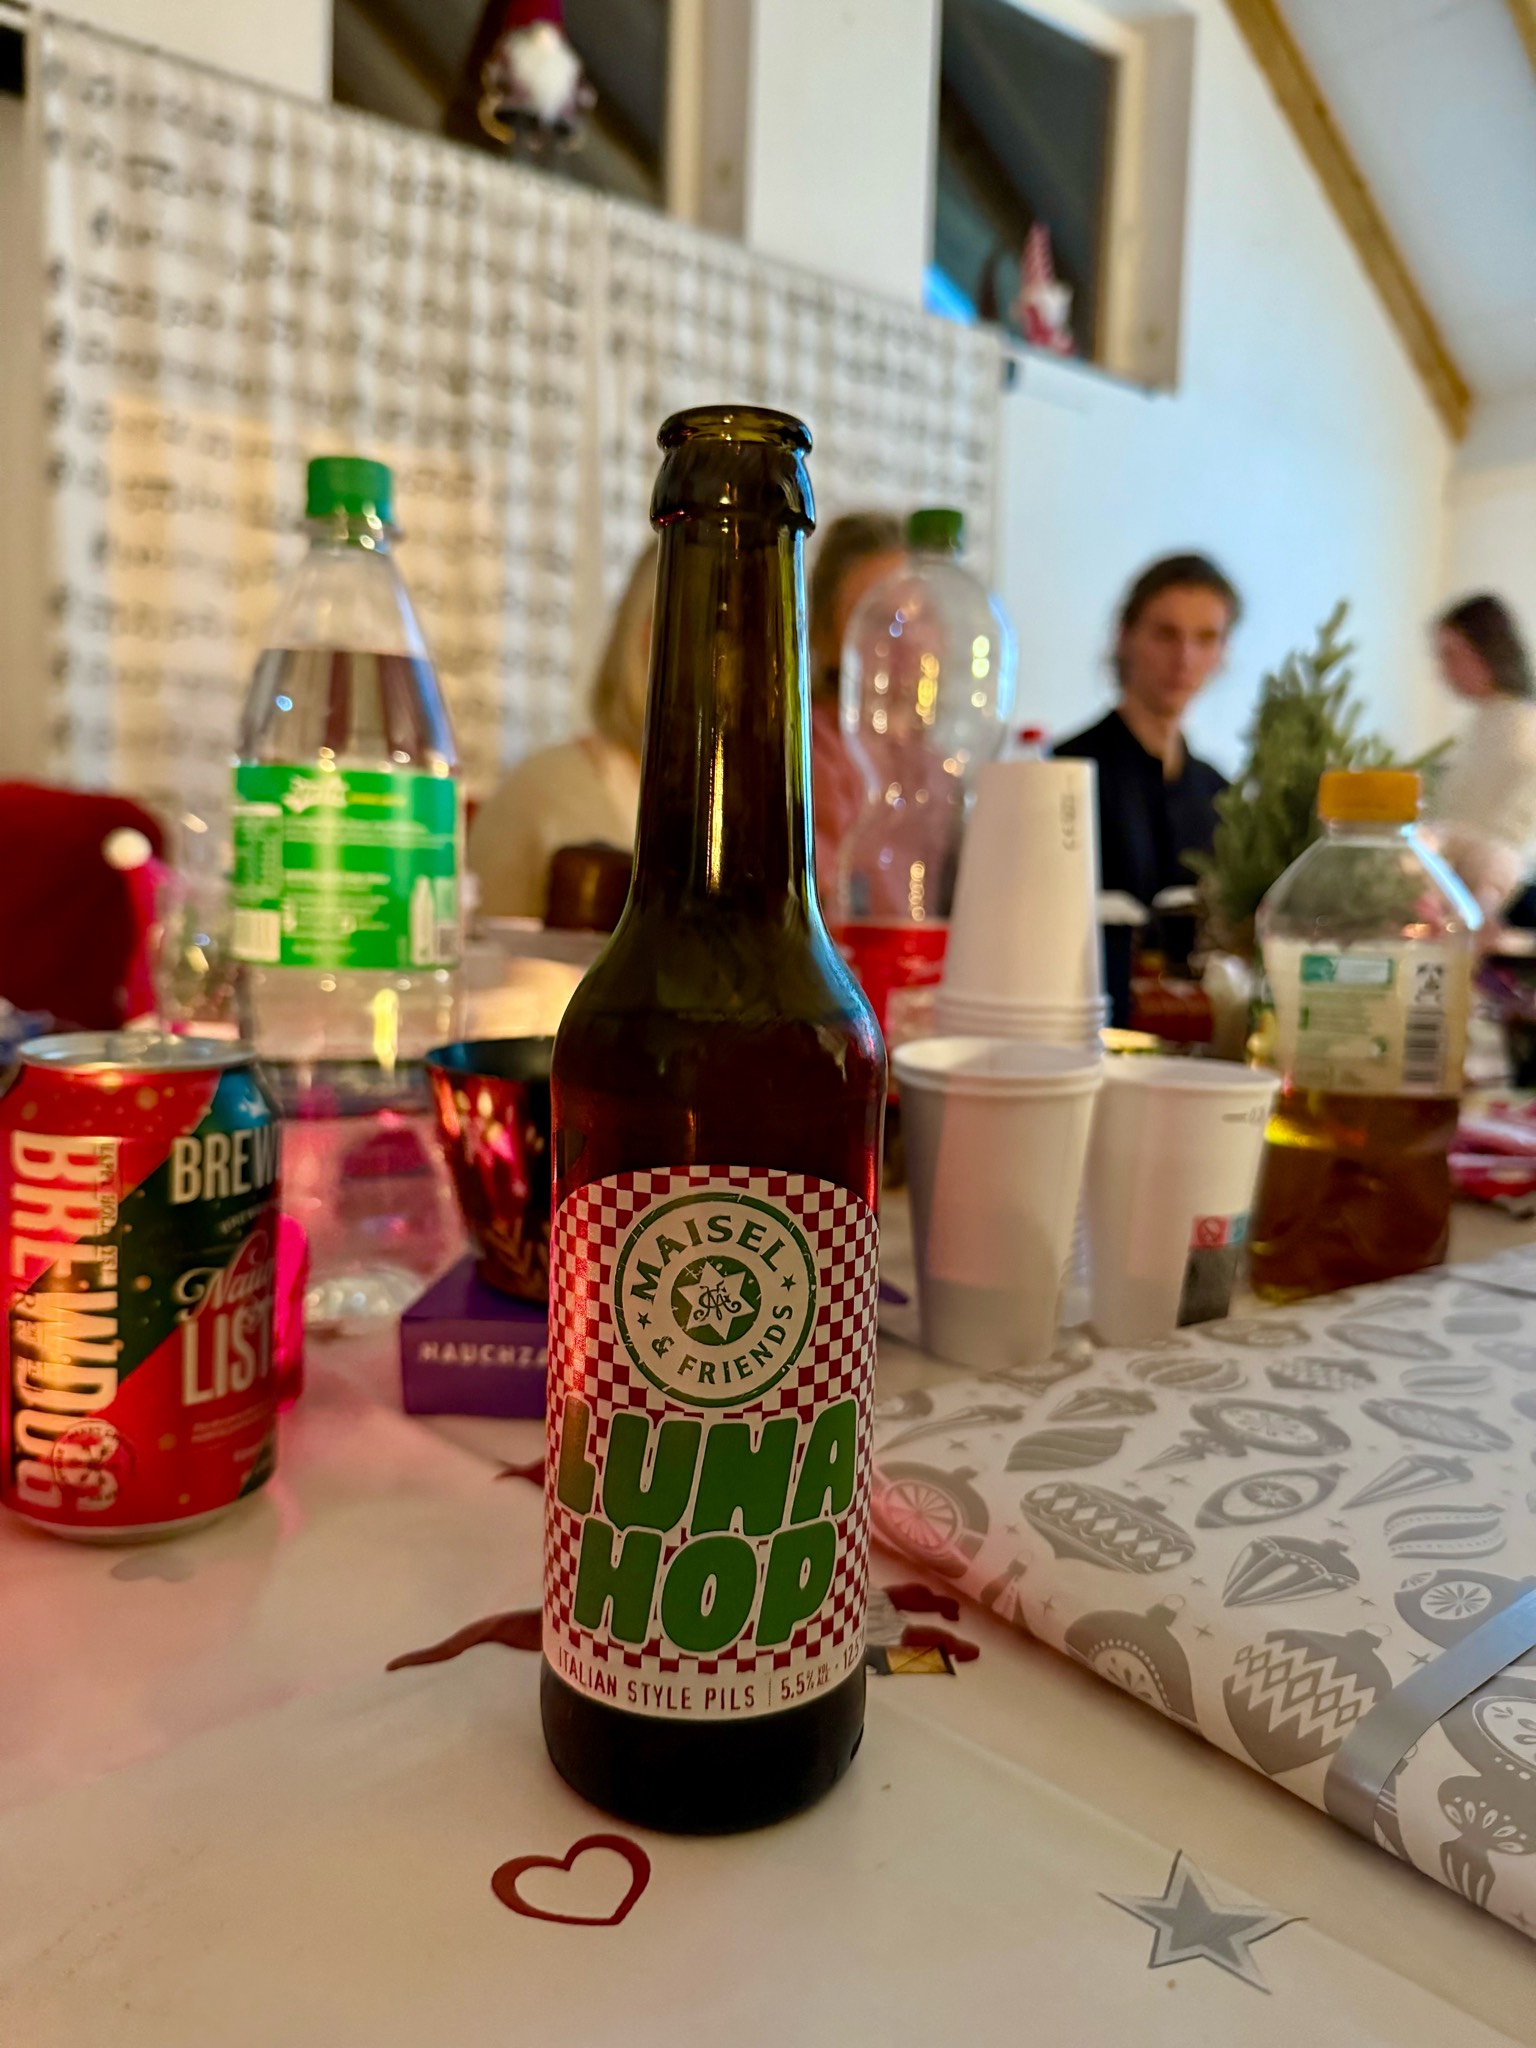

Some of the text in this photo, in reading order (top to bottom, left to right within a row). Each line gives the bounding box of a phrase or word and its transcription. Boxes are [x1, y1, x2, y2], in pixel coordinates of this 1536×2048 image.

[630, 1215, 786, 1305] MAISEL
[10, 1129, 119, 1513] BREWDOG
[182, 1299, 274, 1406] LIST
[651, 1304, 793, 1384] & FRIENDS
[557, 1394, 857, 1536] LUNA
[573, 1516, 837, 1652] HOP
[558, 1648, 617, 1698] ITALIAN
[627, 1681, 691, 1710] STYLE
[704, 1684, 755, 1711] PILS
